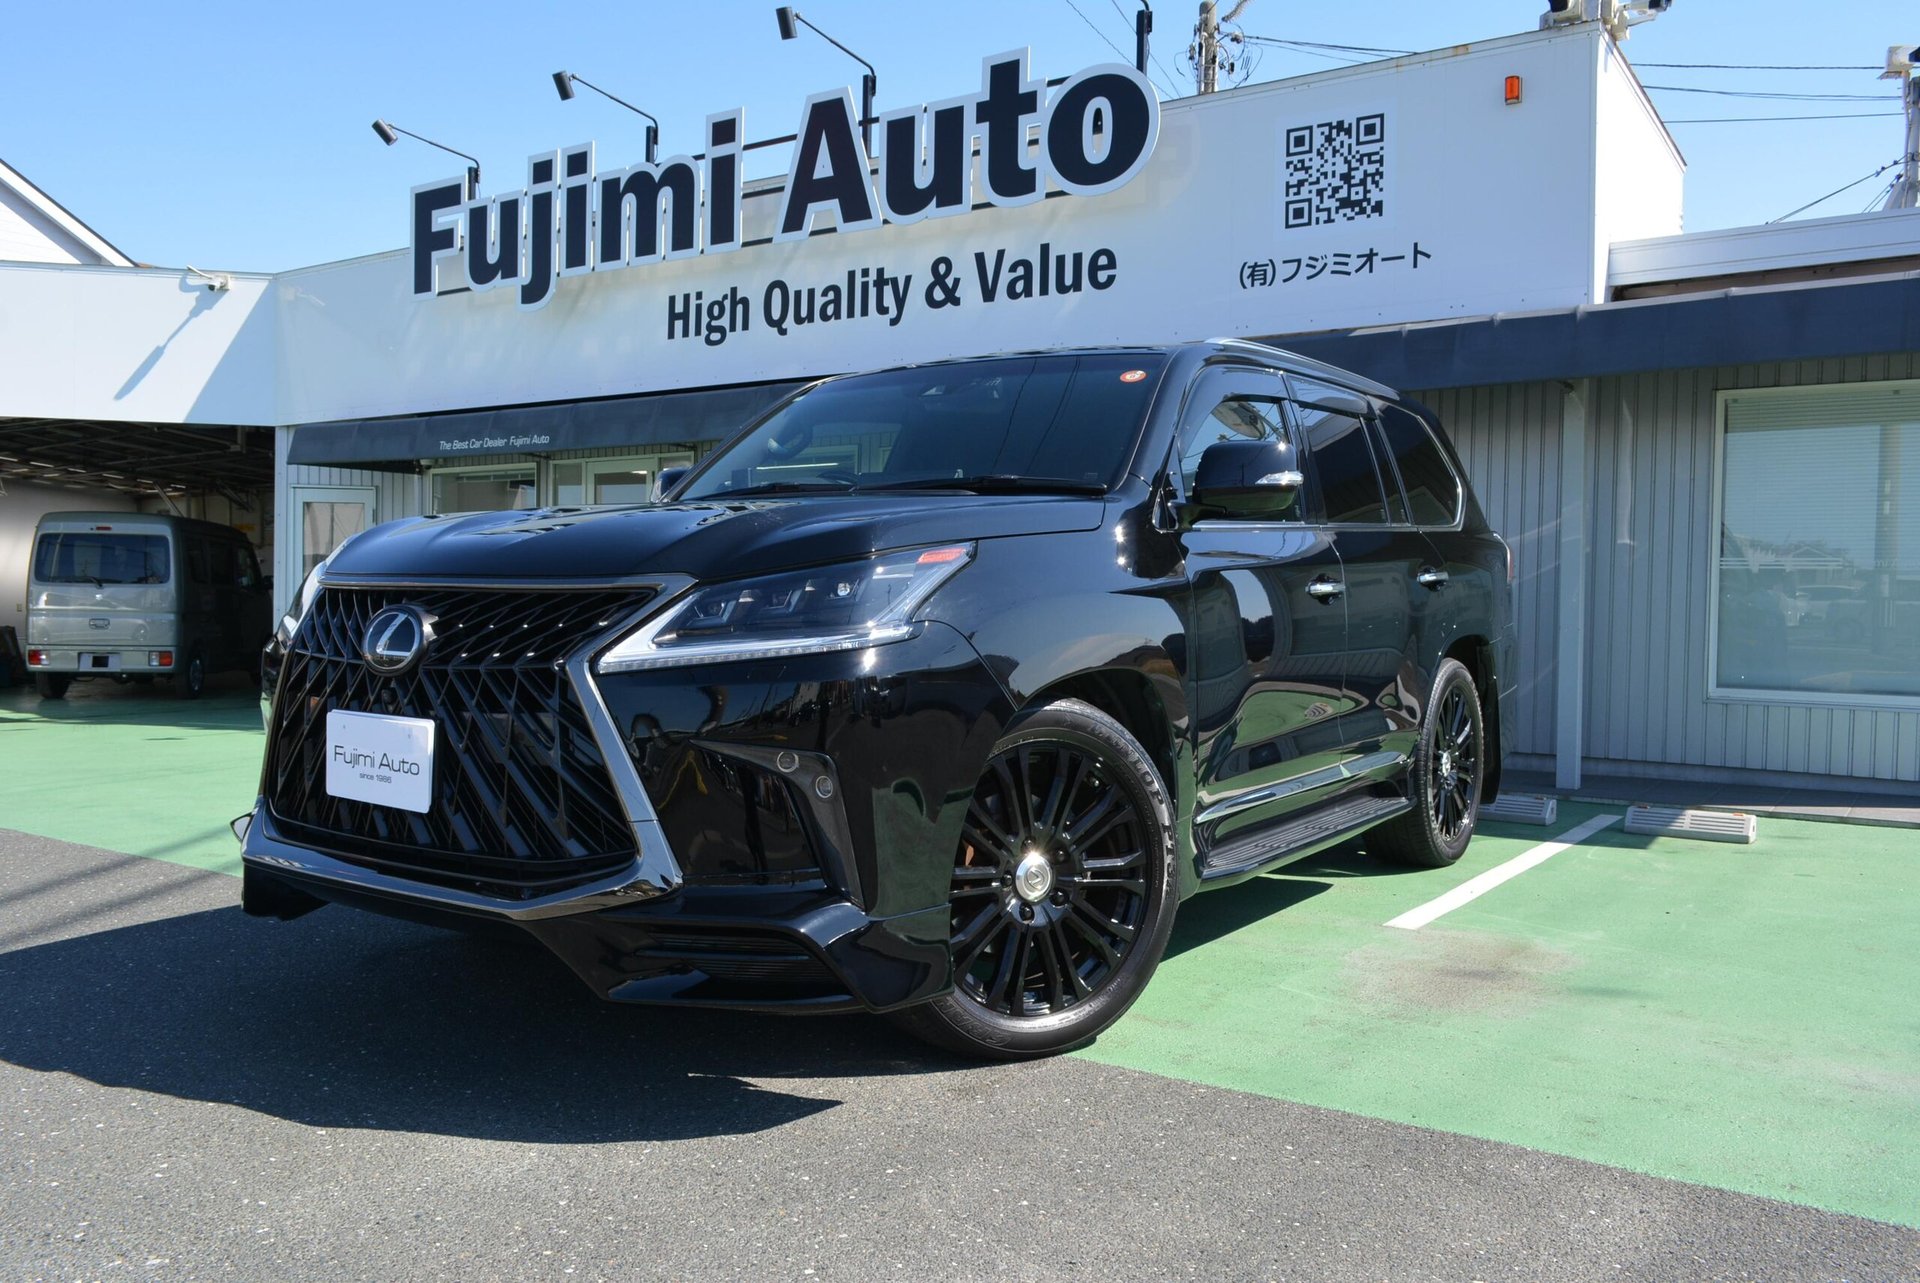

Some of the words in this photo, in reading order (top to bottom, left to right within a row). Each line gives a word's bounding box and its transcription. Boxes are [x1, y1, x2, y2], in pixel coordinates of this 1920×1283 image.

[413, 114, 737, 304] Fujimi
[781, 58, 1152, 232] Auto
[667, 287, 750, 346] High
[763, 268, 912, 337] Quality
[924, 256, 961, 309] &
[974, 243, 1118, 305] Value
[439, 440, 452, 450] The
[452, 440, 469, 450] Best
[469, 438, 483, 449] Car
[483, 437, 508, 448] Dealer
[509, 434, 531, 447] Fujimi
[531, 434, 550, 444] Auto
[333, 744, 375, 769] Fujimi
[378, 752, 420, 776] Auto
[359, 772, 375, 781] since
